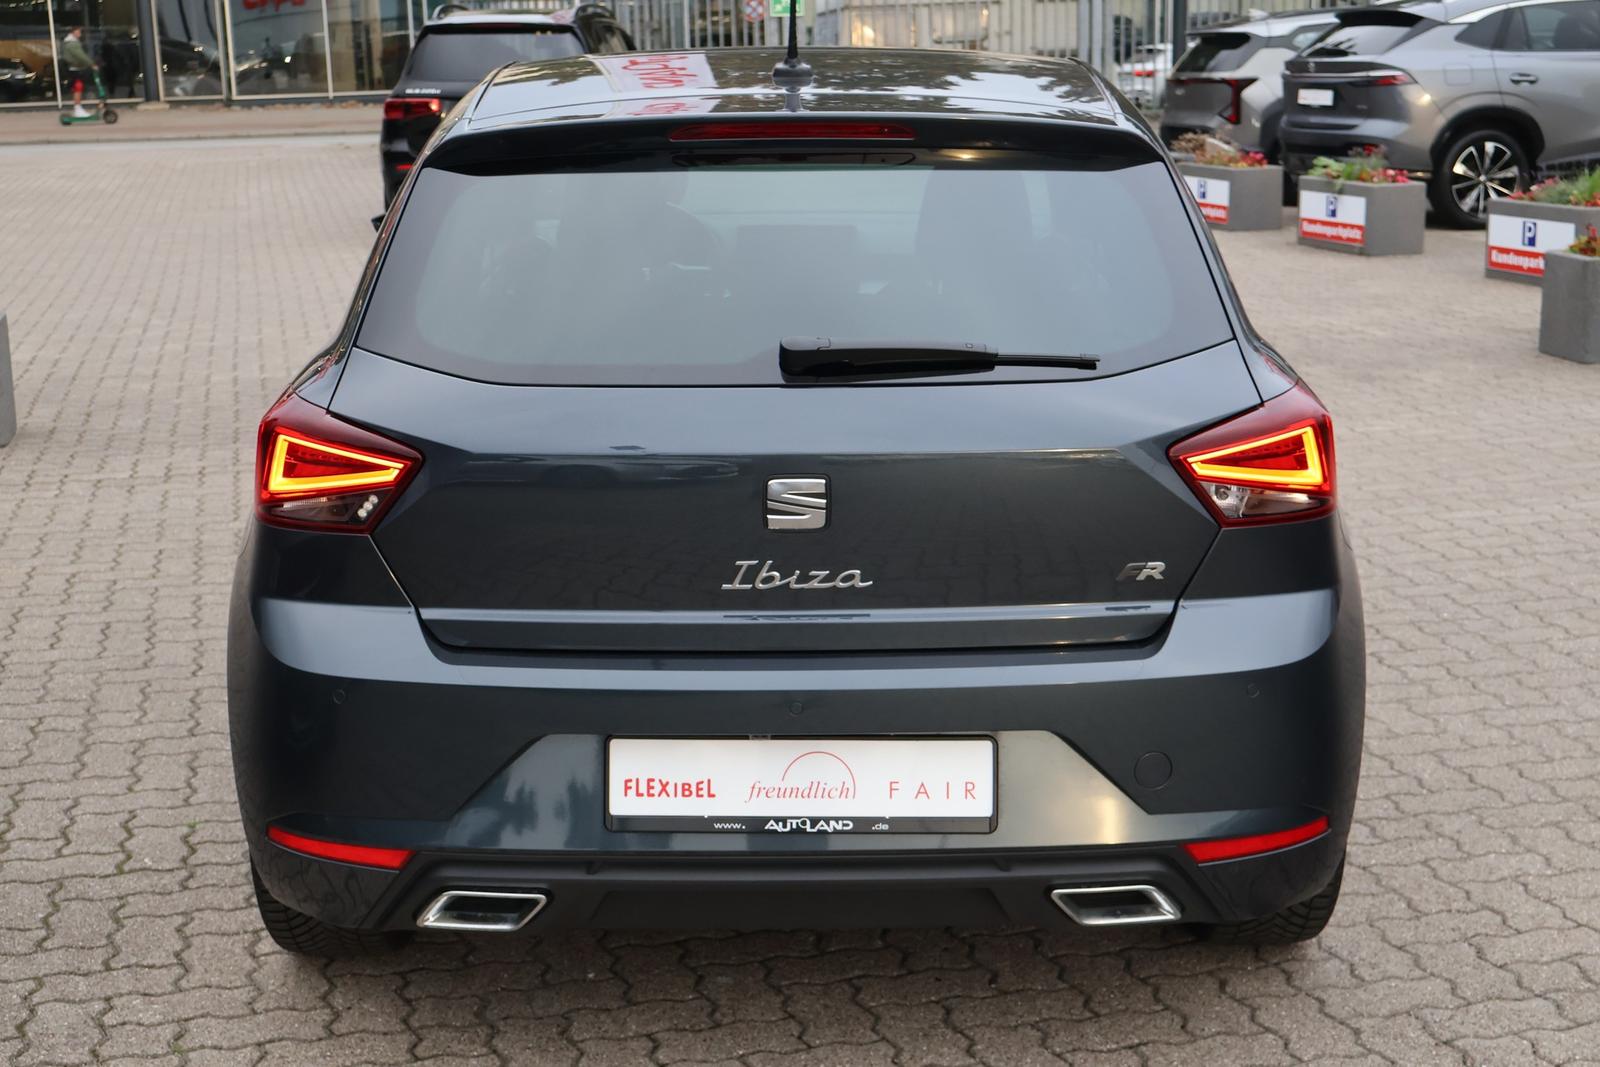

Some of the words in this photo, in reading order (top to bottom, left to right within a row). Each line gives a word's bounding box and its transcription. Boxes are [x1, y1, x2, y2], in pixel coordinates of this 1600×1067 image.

[1524, 221, 1535, 246] P
[1491, 249, 1545, 270] Kundenpark
[721, 560, 873, 590] Ibiza
[1116, 561, 1166, 581] FR
[623, 778, 716, 798] FLEXIBEL
[744, 780, 850, 803] freundlich
[889, 781, 976, 800] FAIR
[764, 817, 854, 833] AUTOLAND
